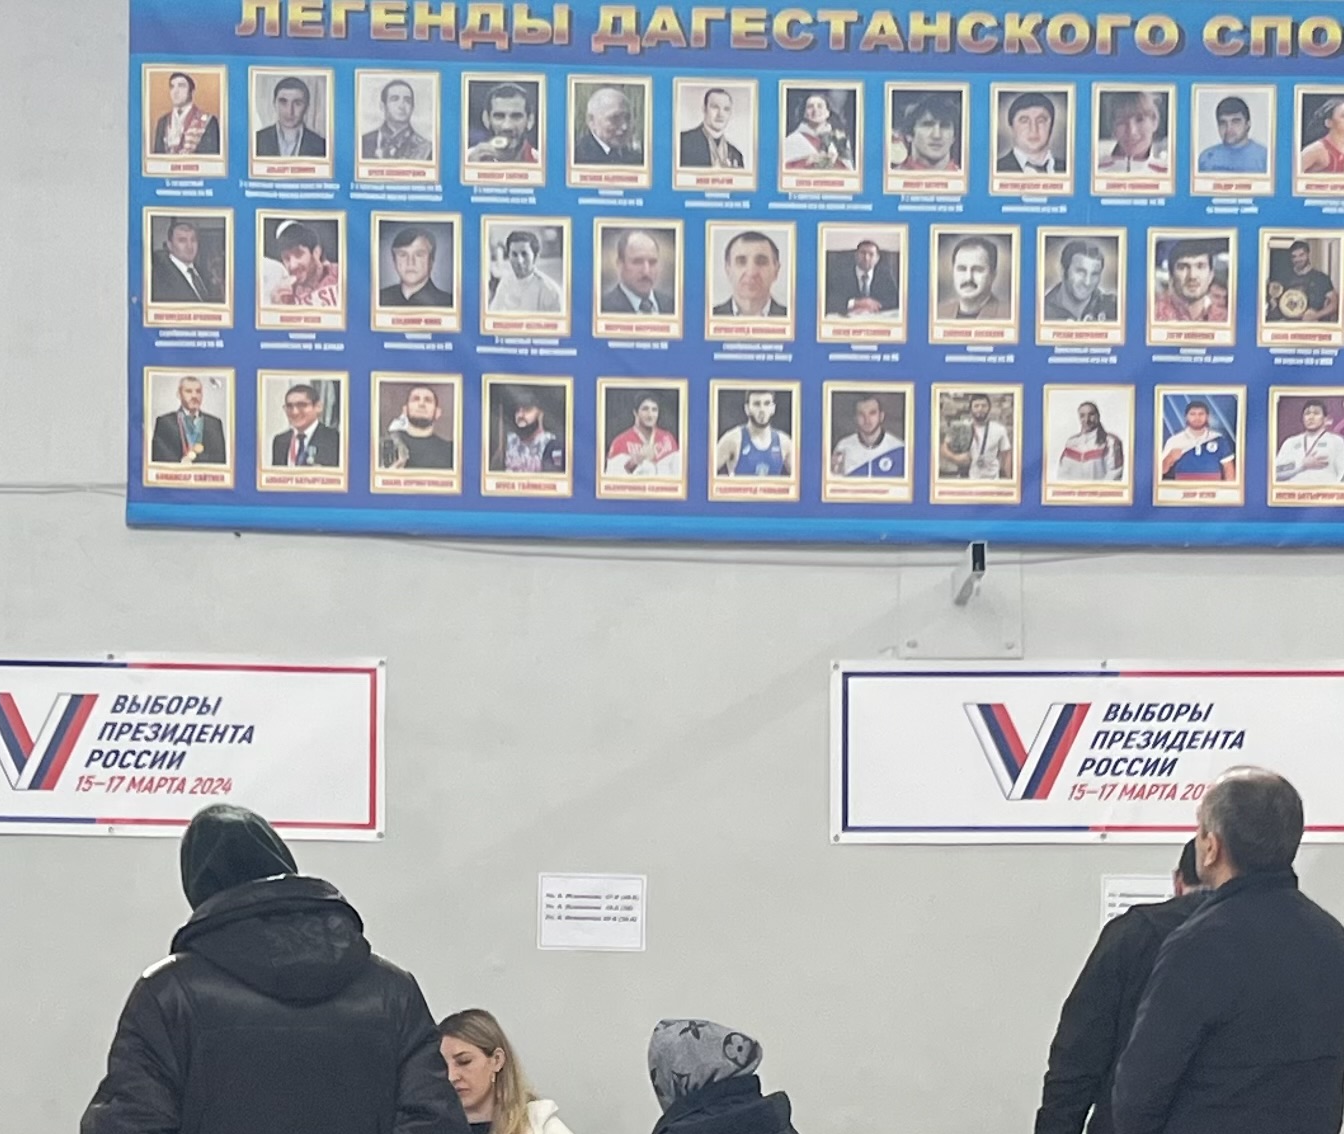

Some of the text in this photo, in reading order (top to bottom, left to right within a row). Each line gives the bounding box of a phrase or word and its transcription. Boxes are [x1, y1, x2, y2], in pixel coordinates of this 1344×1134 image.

[235, 0, 573, 51] ЛЕГЕНДЫ
[591, 4, 1182, 56] ДАГЕСТАНСКОГО
[110, 694, 224, 716] ВЫБОРЫ
[1102, 703, 1214, 723] ВЫБОРЫ
[97, 721, 255, 746] ПРЕЗИДЕНТА
[1090, 729, 1246, 753] ПРЕЗИДЕНТА
[85, 749, 187, 771] РОССИИ
[1077, 757, 1179, 778] РОССИИ
[127, 776, 187, 794] МАРТА
[189, 777, 233, 795] 2024
[1120, 783, 1179, 801] МАРТА
[1180, 783, 1213, 801] 20
